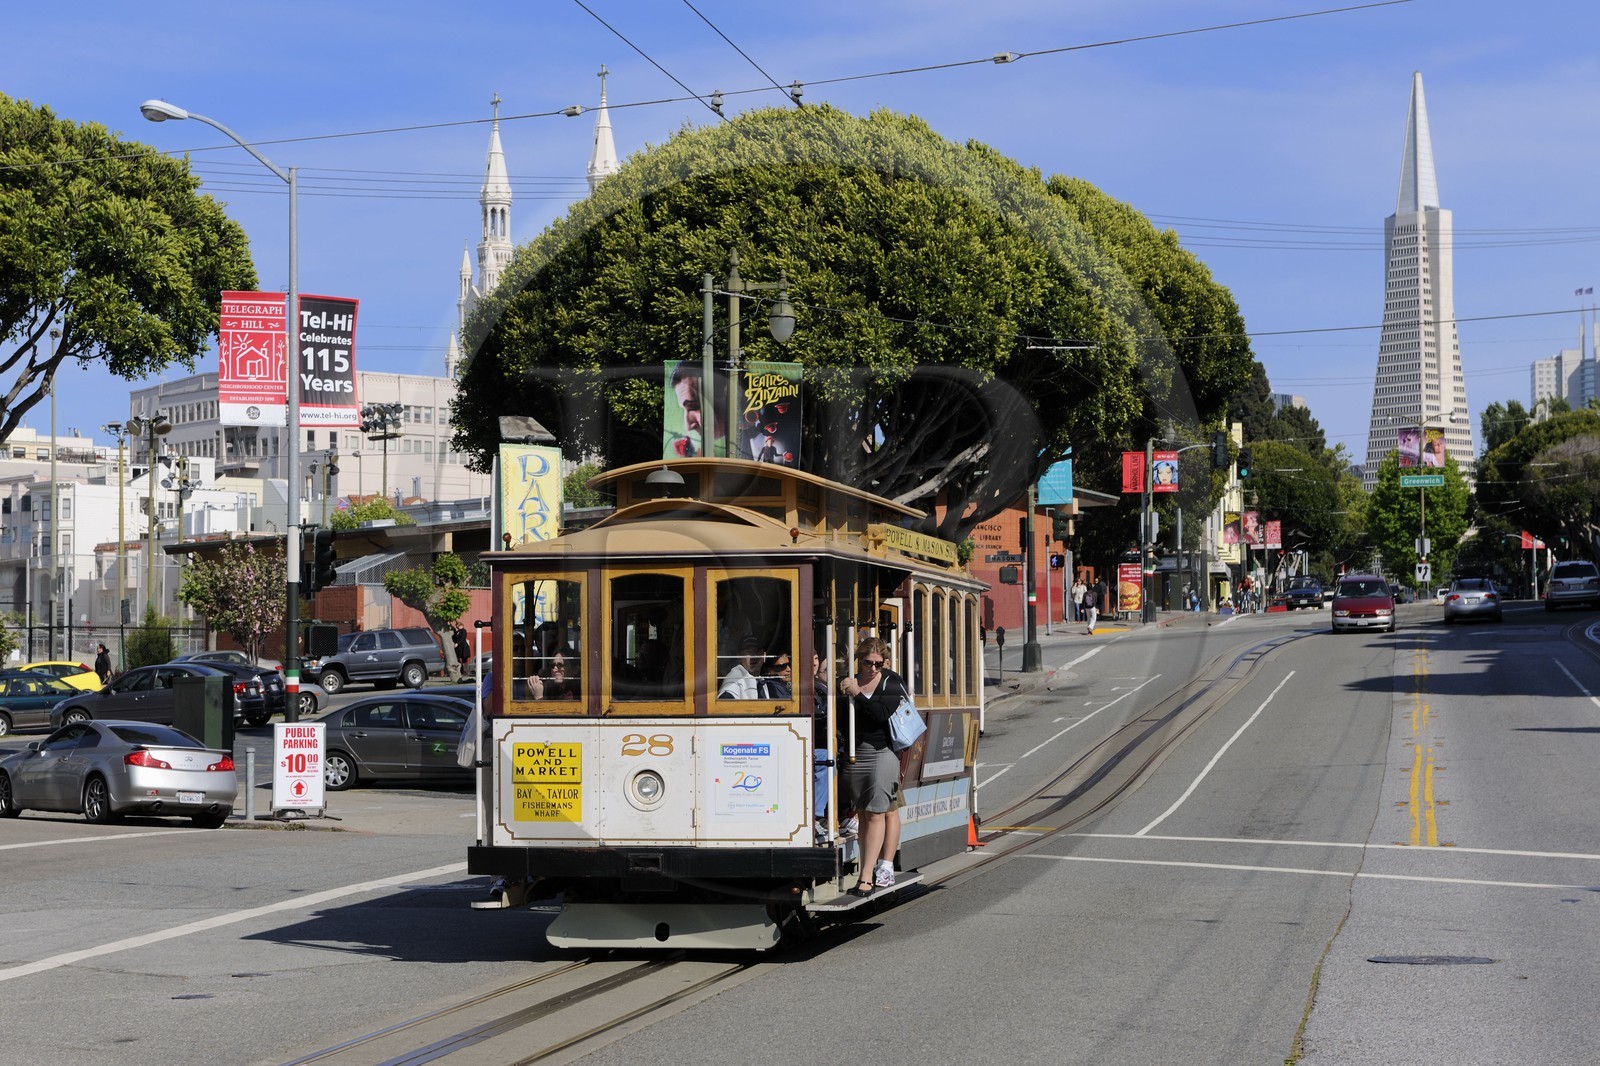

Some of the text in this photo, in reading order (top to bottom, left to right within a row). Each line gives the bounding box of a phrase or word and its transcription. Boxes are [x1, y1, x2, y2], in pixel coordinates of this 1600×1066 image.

[224, 305, 283, 315] TELEGRAPH
[240, 320, 265, 329] HILL
[300, 311, 353, 332] Tel-Hi
[300, 332, 352, 345] Celebrates
[302, 347, 350, 373] 115
[300, 373, 353, 393] Years
[300, 411, 357, 421] www.tel-hi.org
[886, 528, 912, 549] POWELL
[922, 539, 944, 557] MASON
[285, 727, 316, 738] PUBLIC
[283, 739, 318, 749] PARKING
[621, 733, 674, 757] 28
[517, 748, 577, 758] POWELL
[723, 747, 757, 756] Kogenate
[516, 767, 578, 776] MARKET
[517, 789, 533, 799] BAY
[547, 789, 579, 799] TAYLOR
